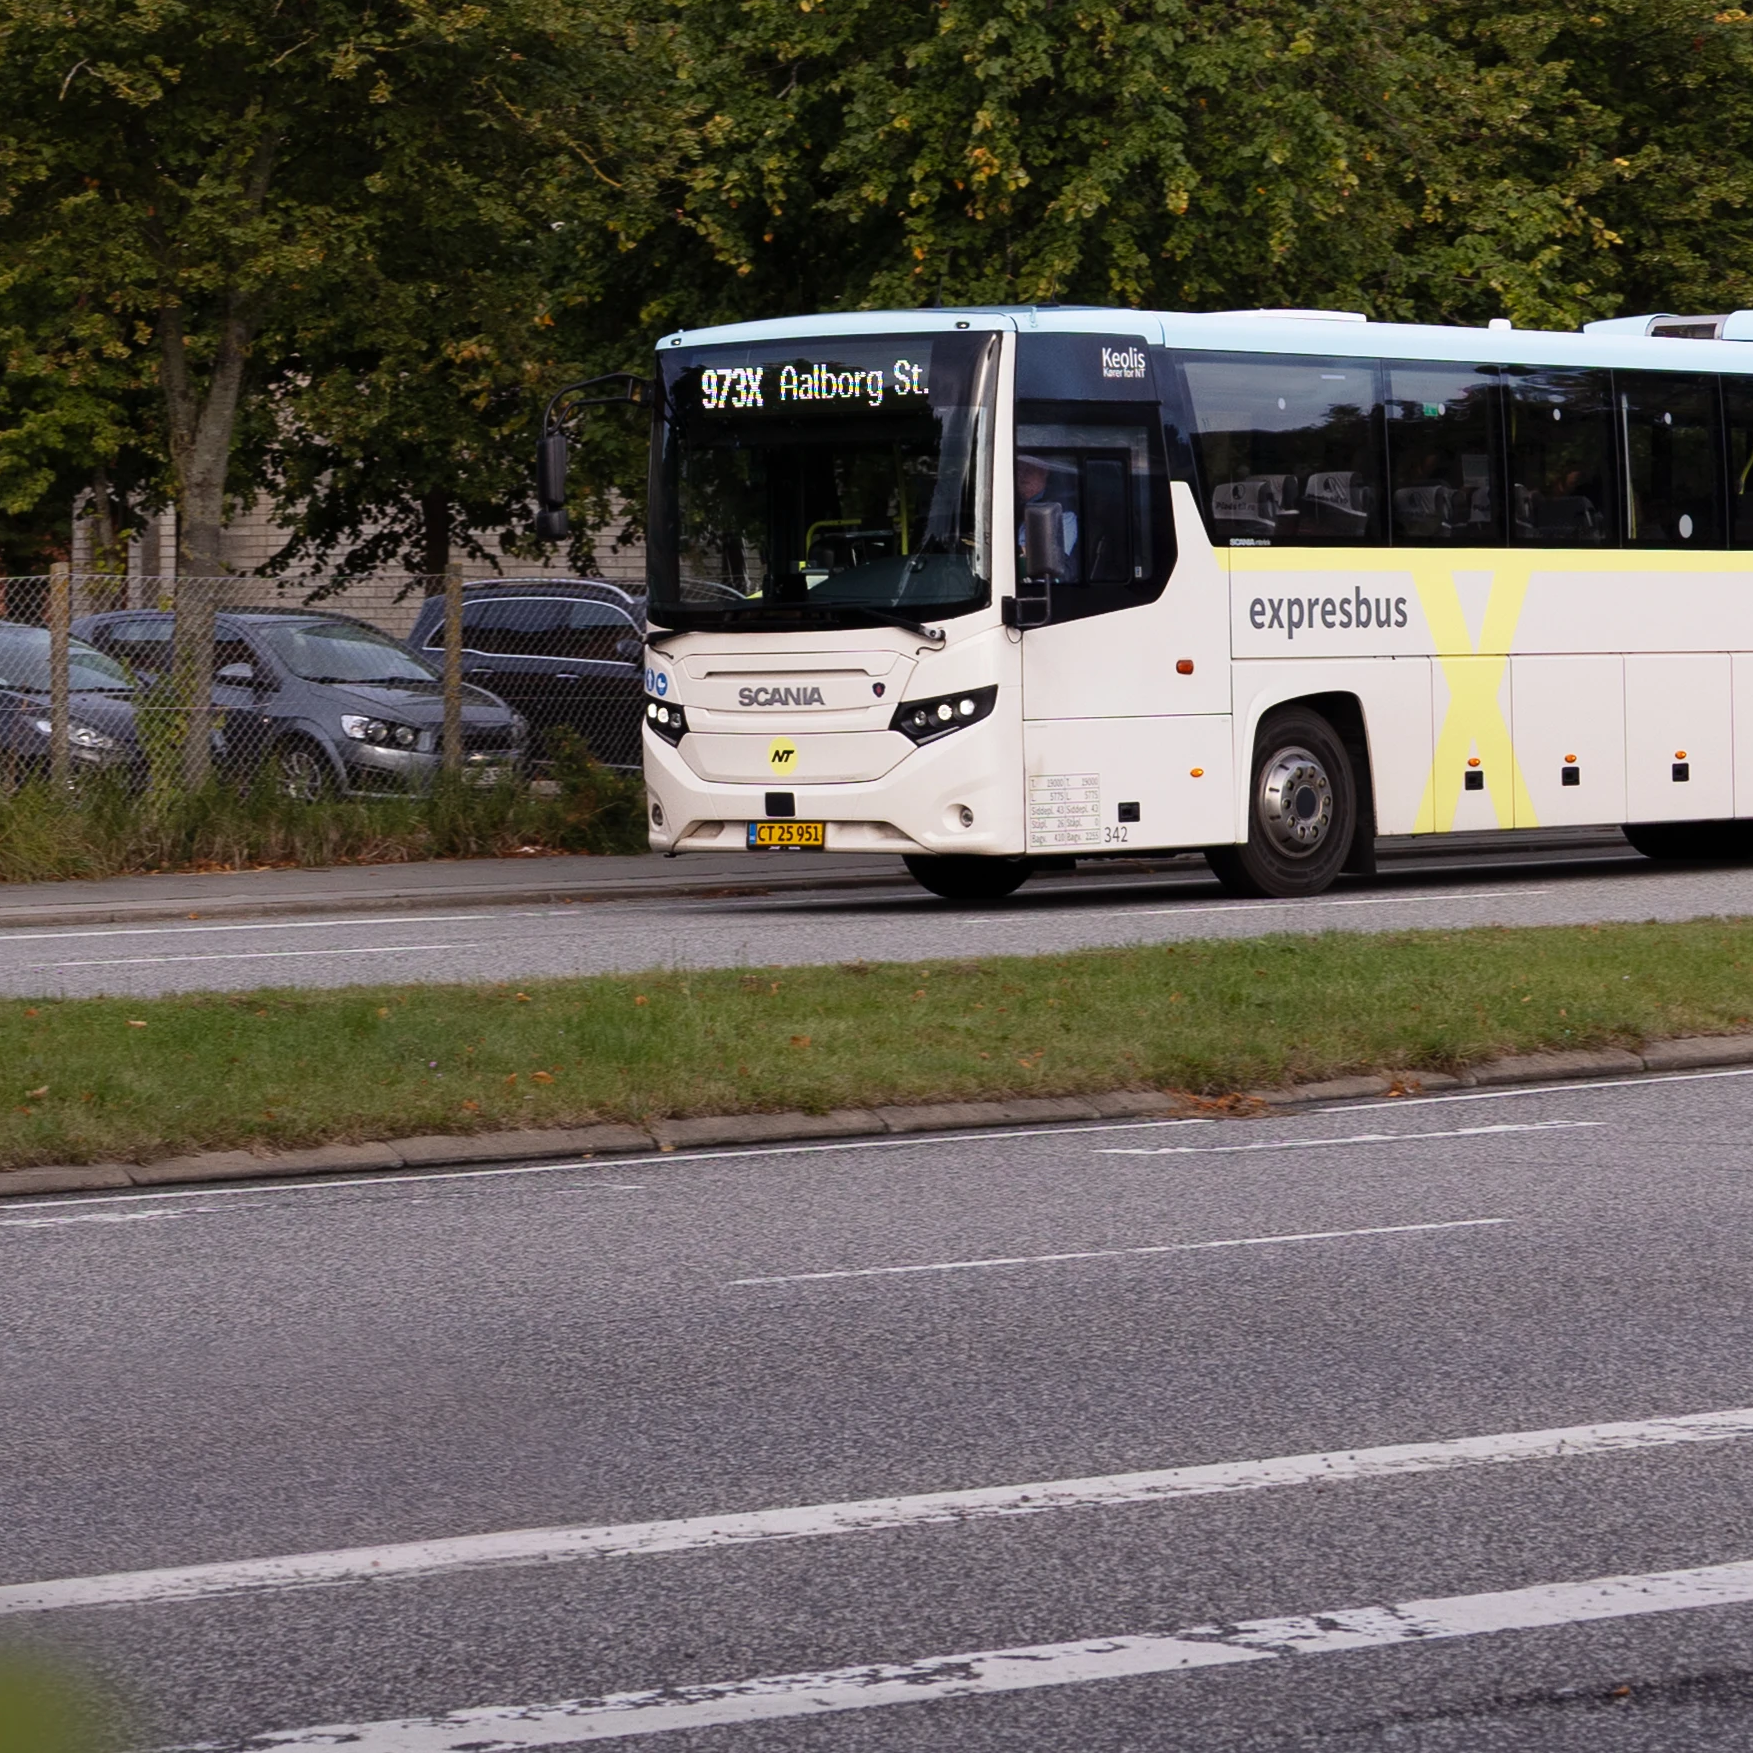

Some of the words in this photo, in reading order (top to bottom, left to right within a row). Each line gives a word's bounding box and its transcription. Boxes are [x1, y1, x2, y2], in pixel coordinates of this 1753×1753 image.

[1102, 347, 1146, 368] Keolis
[1135, 368, 1146, 378] NT
[702, 368, 763, 408] 973X
[780, 364, 884, 407] Aalborg
[894, 359, 929, 395] St.
[1249, 586, 1408, 640] expresbus
[738, 687, 826, 707] SCANIA
[771, 750, 795, 763] NT
[757, 826, 775, 842] CT
[778, 826, 793, 842] 25
[796, 826, 820, 842] 951
[1104, 826, 1128, 843] 342
